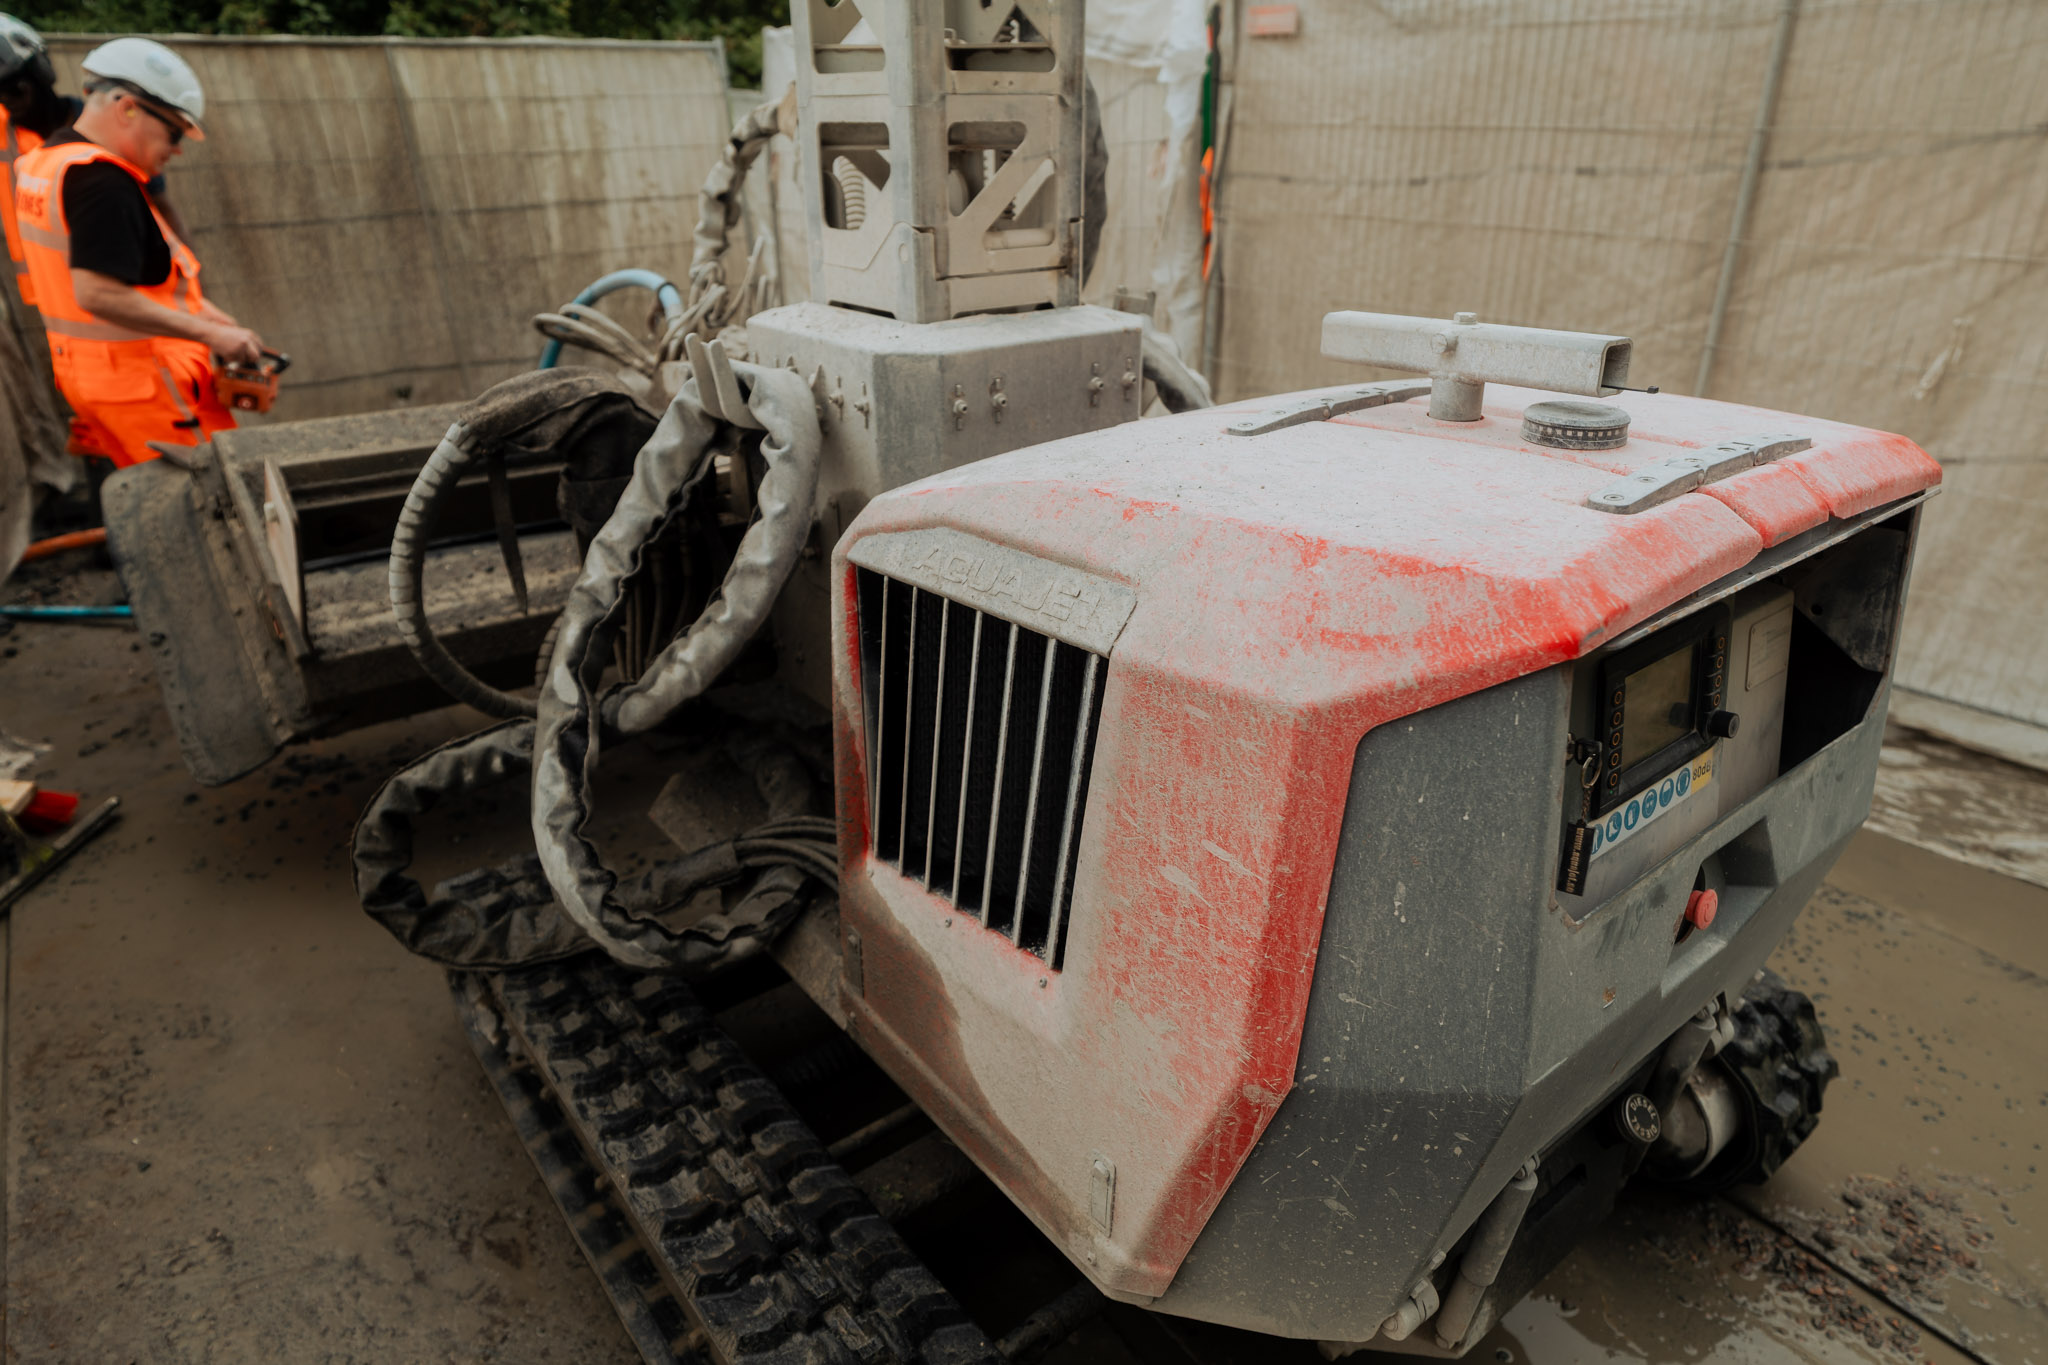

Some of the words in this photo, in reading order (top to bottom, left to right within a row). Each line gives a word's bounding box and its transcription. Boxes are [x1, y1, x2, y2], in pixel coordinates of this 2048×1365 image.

[911, 547, 1106, 632] AQUAJET
[1630, 1097, 1656, 1119] DIESEL
[1631, 1116, 1657, 1138] DIESEL
